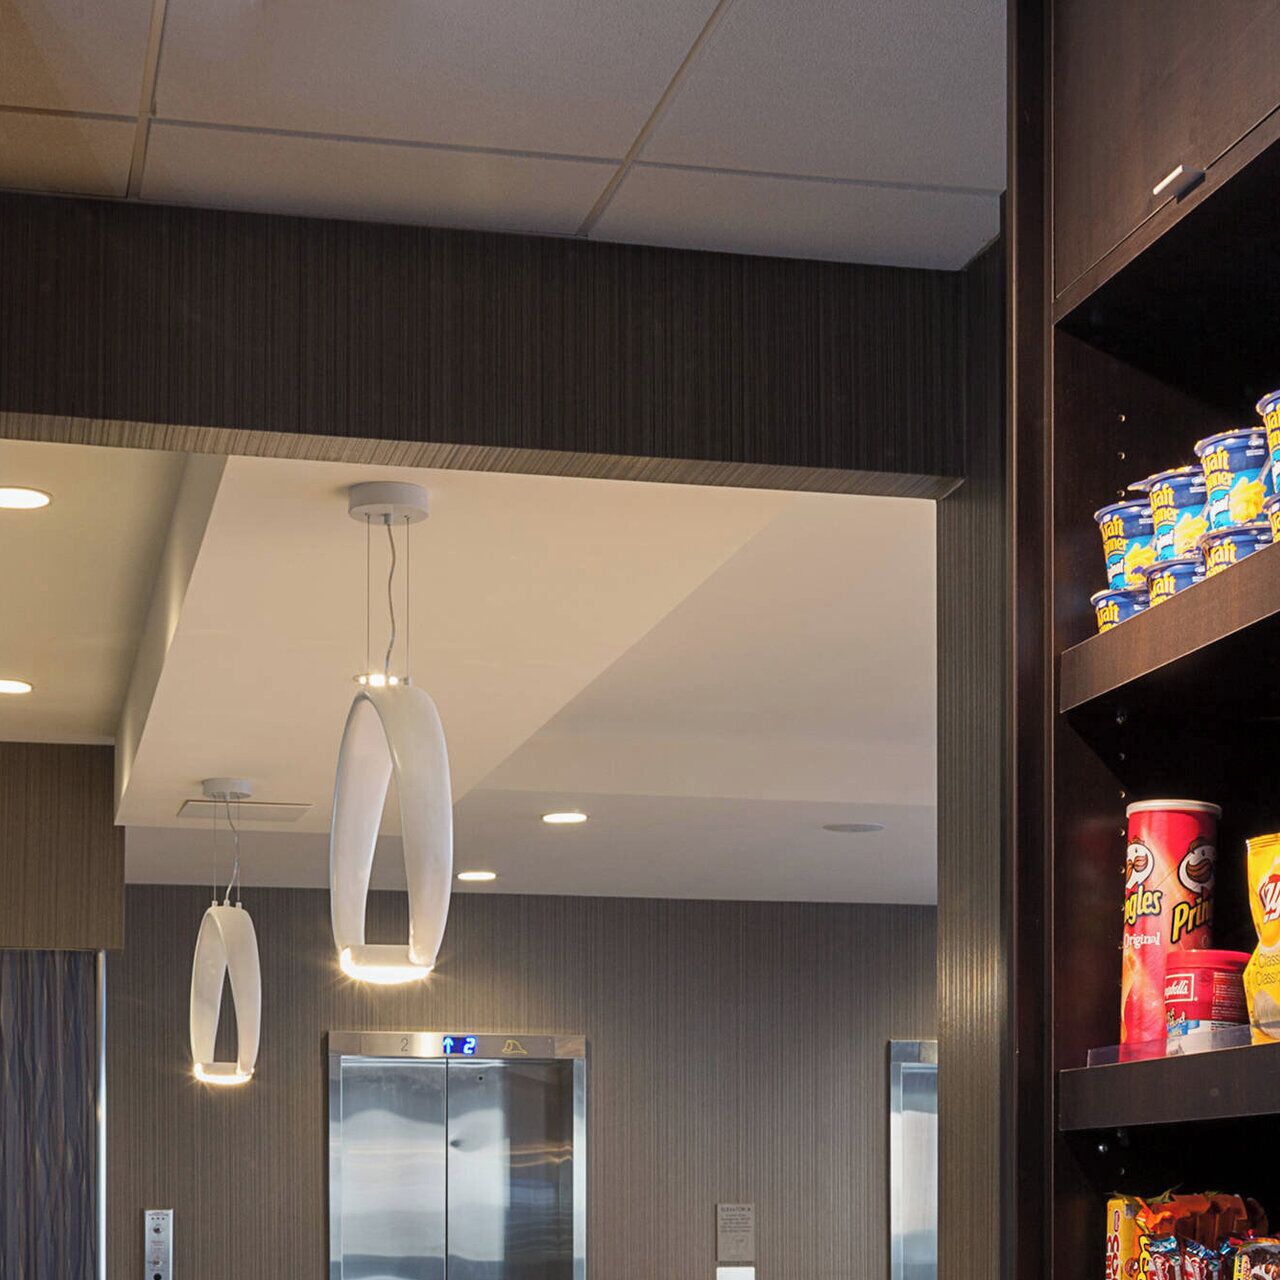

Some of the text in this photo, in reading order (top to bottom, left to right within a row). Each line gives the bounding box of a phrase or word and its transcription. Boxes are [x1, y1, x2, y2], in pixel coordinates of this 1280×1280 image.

[1171, 898, 1212, 944] Prin
[400, 1038, 409, 1052] 2
[463, 1037, 477, 1055] 2
